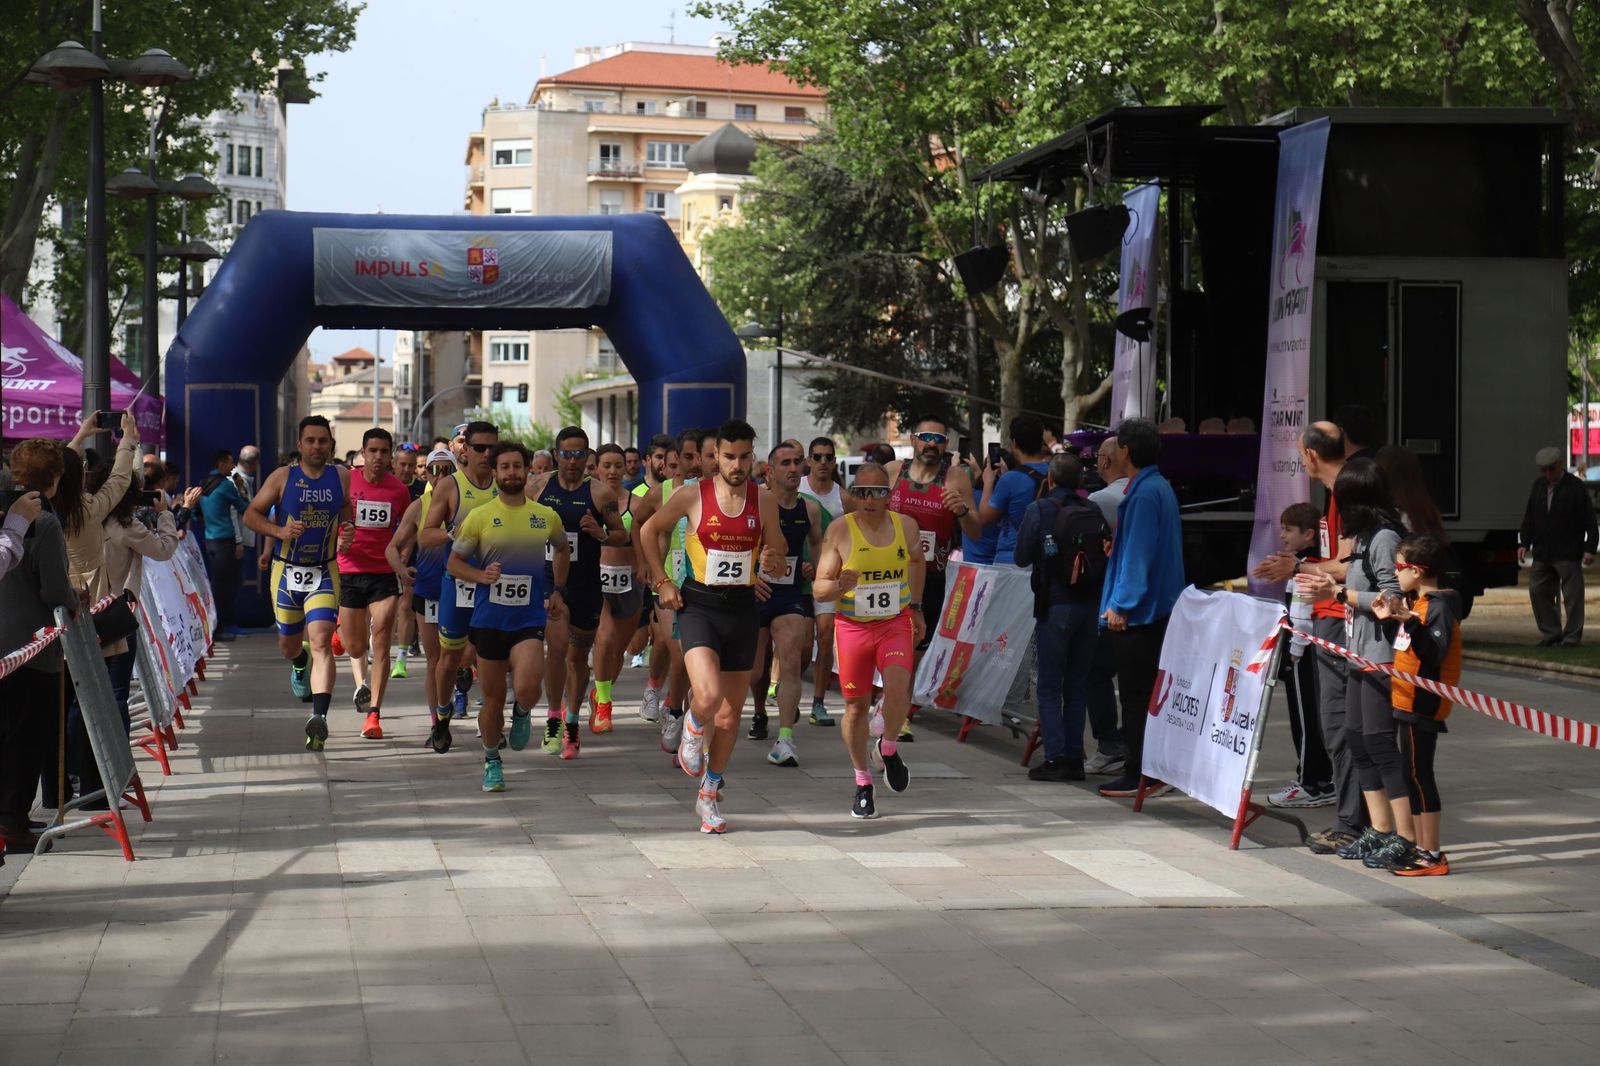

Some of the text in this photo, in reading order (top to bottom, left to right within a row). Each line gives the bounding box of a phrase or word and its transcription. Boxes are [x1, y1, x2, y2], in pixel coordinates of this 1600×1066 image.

[354, 245, 390, 258] NOS
[504, 270, 576, 284] Junta de
[299, 488, 333, 502] JESUS
[904, 497, 921, 506] APIS
[922, 500, 942, 510] DURI
[360, 507, 388, 522] 159
[717, 561, 743, 578] 25
[862, 568, 904, 581] TEAM
[293, 571, 314, 585] 92
[601, 573, 628, 587] 219
[495, 583, 528, 599] 156
[866, 592, 891, 609] 18
